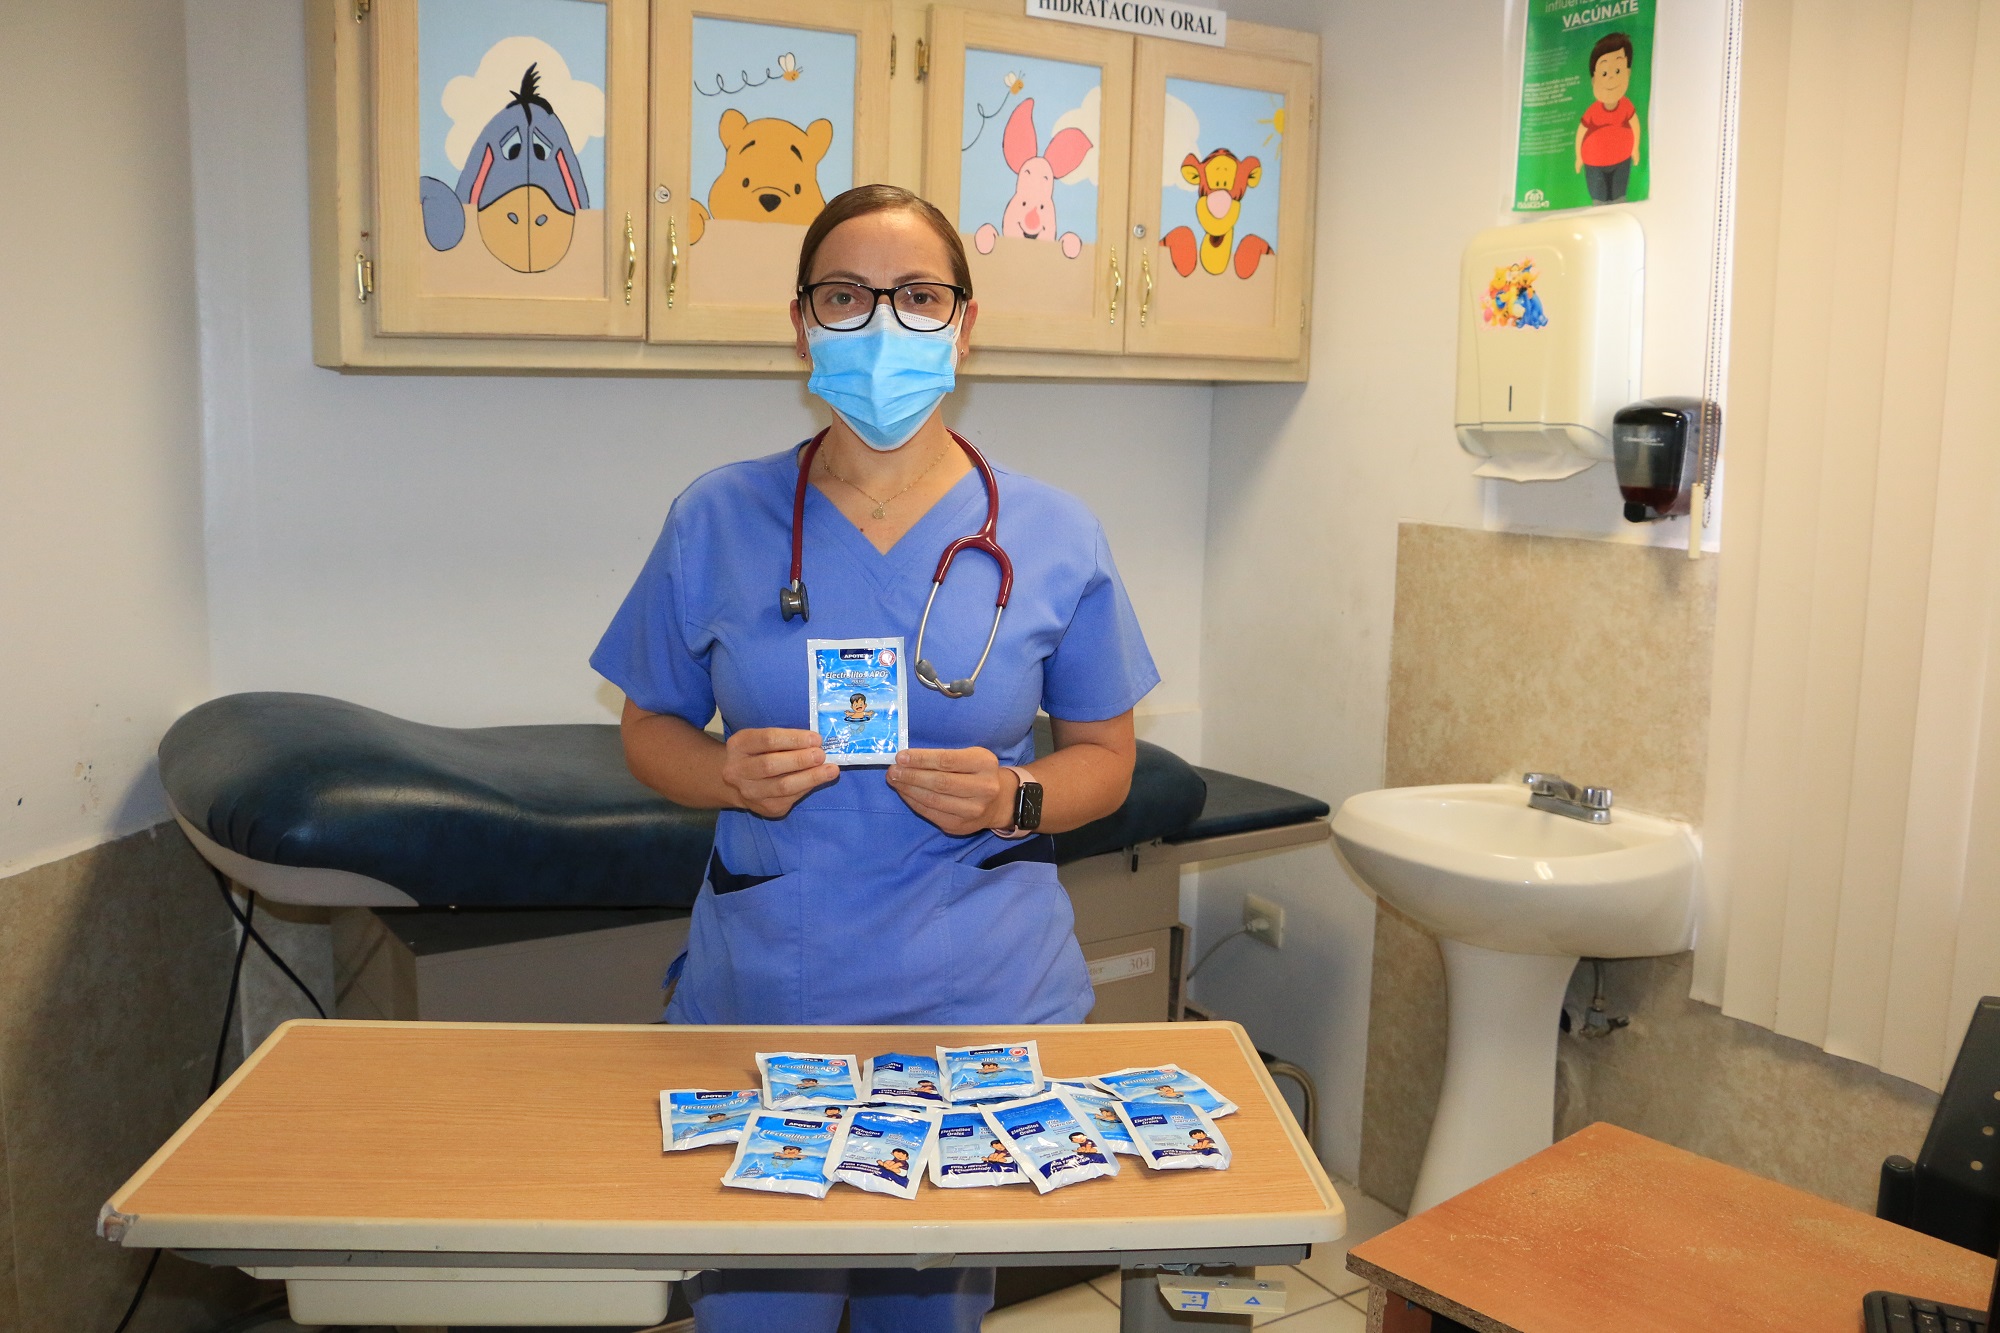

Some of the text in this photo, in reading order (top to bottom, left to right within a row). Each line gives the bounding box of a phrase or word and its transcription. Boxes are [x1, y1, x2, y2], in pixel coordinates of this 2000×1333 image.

[1545, 0, 1594, 12] influenz
[1039, 0, 1217, 35] HIDRATACION ORAL
[1562, 0, 1638, 28] VACÚNATE
[762, 1129, 810, 1139] Electrolitos
[1011, 1123, 1039, 1135] Electrolitos
